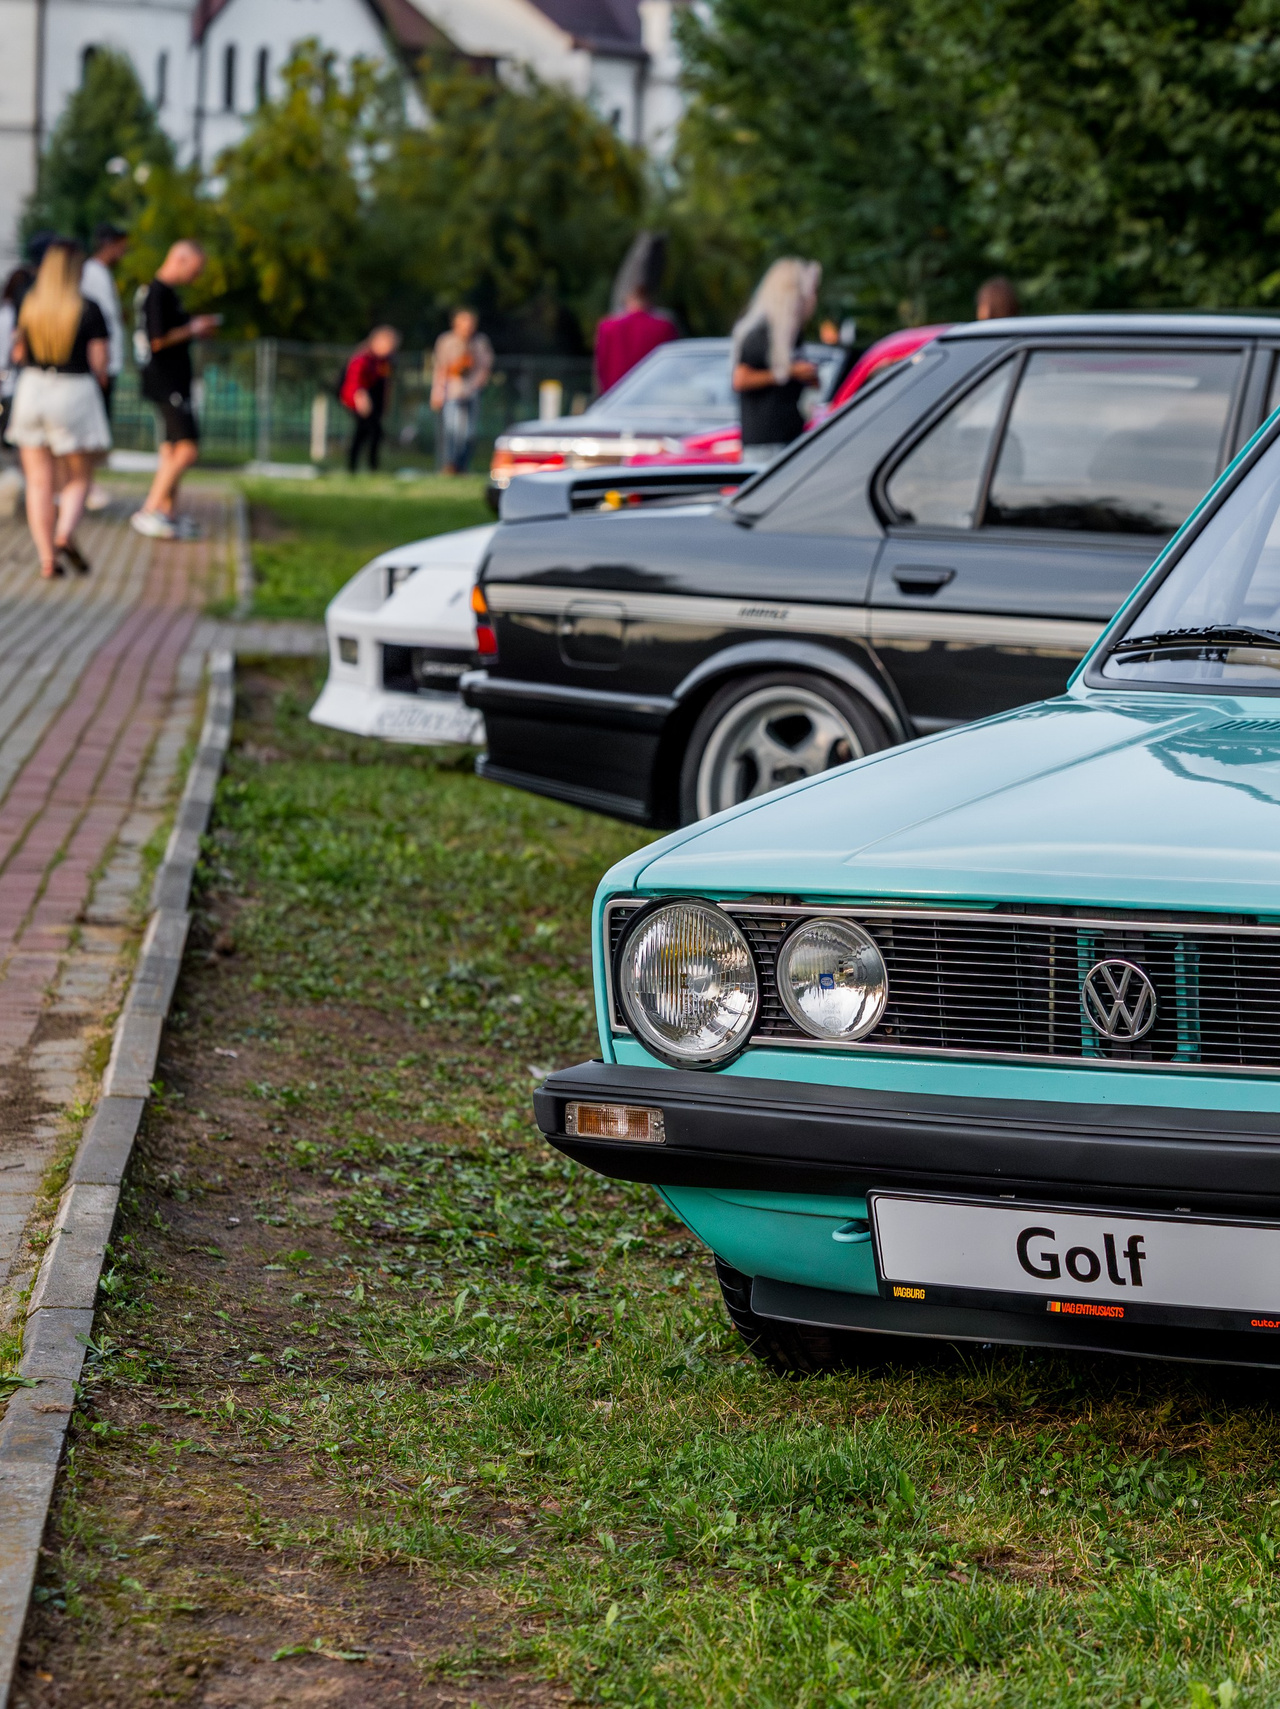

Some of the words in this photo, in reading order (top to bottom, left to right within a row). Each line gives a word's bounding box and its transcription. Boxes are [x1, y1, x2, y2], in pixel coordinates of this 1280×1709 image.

[1016, 1226, 1147, 1287] Golf
[893, 1286, 926, 1300] VAGBURG
[1075, 1303, 1125, 1318] ENTHUSIASTS
